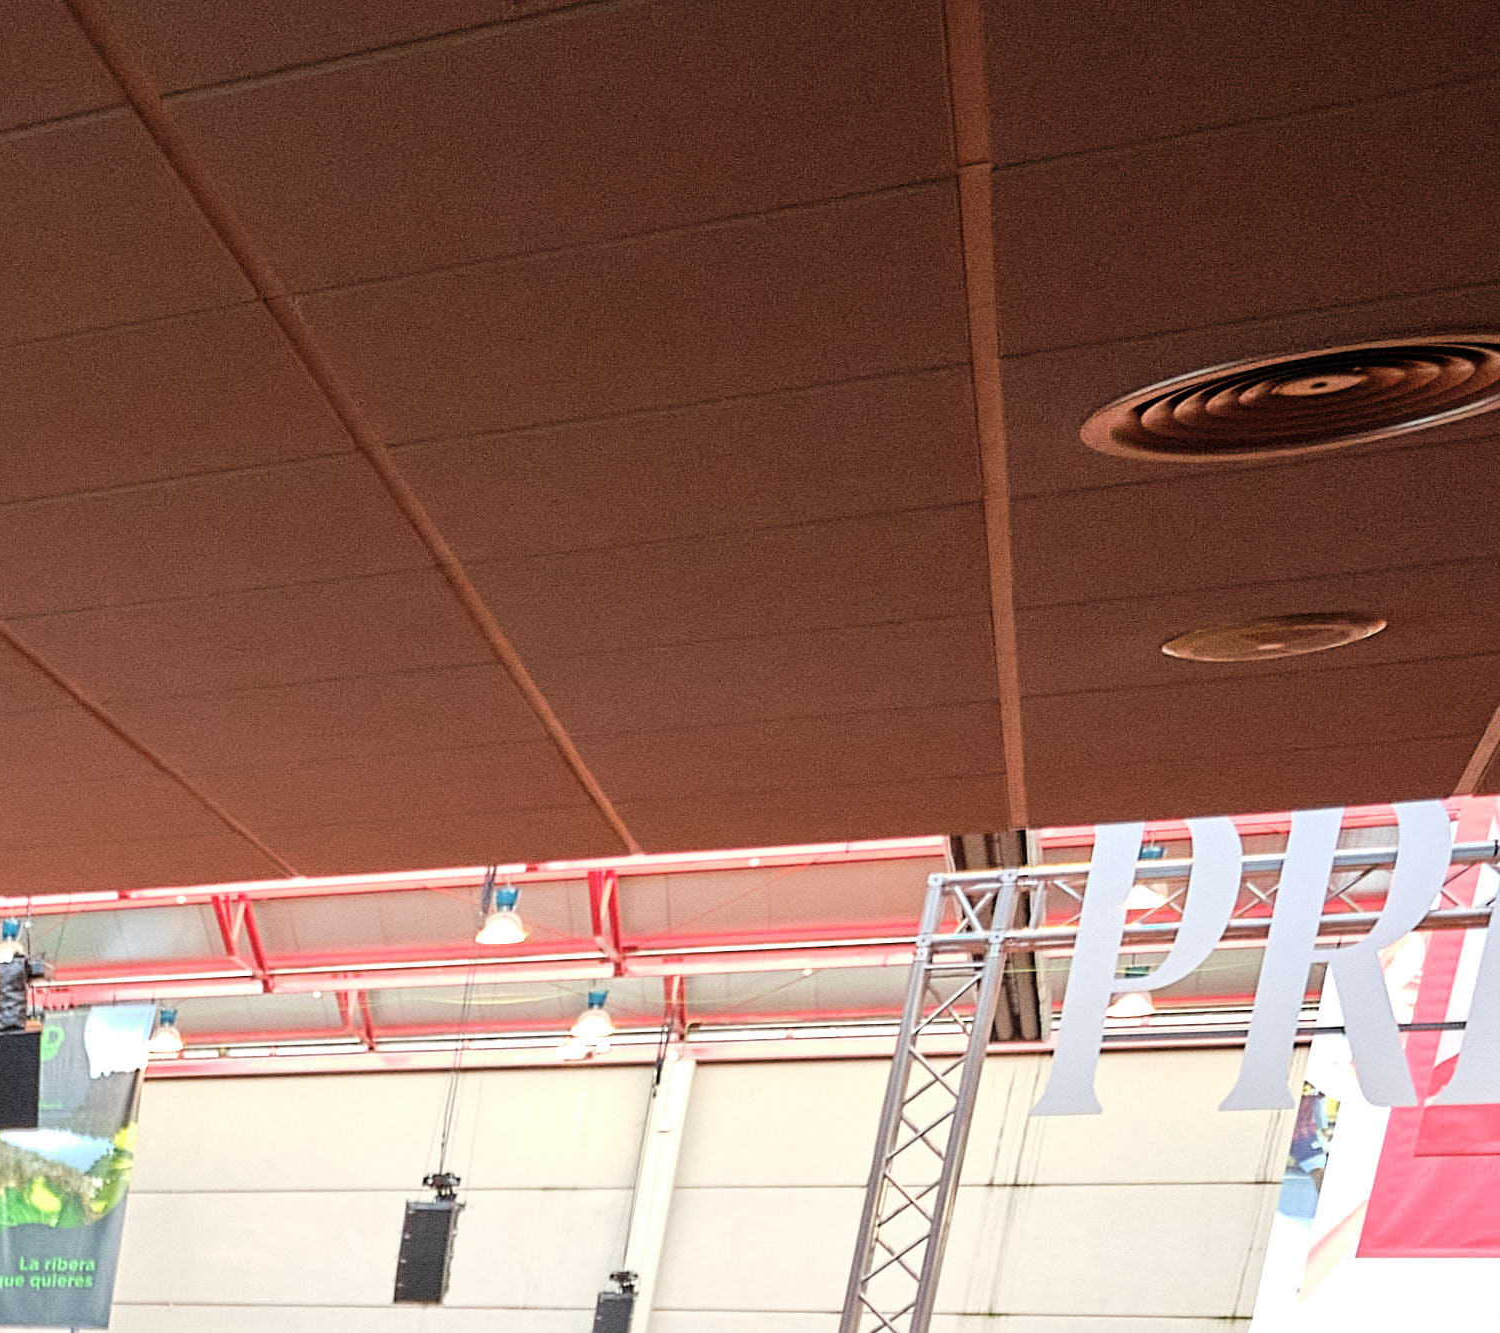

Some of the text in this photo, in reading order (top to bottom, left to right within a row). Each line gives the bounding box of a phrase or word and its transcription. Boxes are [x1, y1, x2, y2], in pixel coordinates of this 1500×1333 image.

[19, 1256, 96, 1271] La ribera
[29, 1273, 93, 1290] quieres
